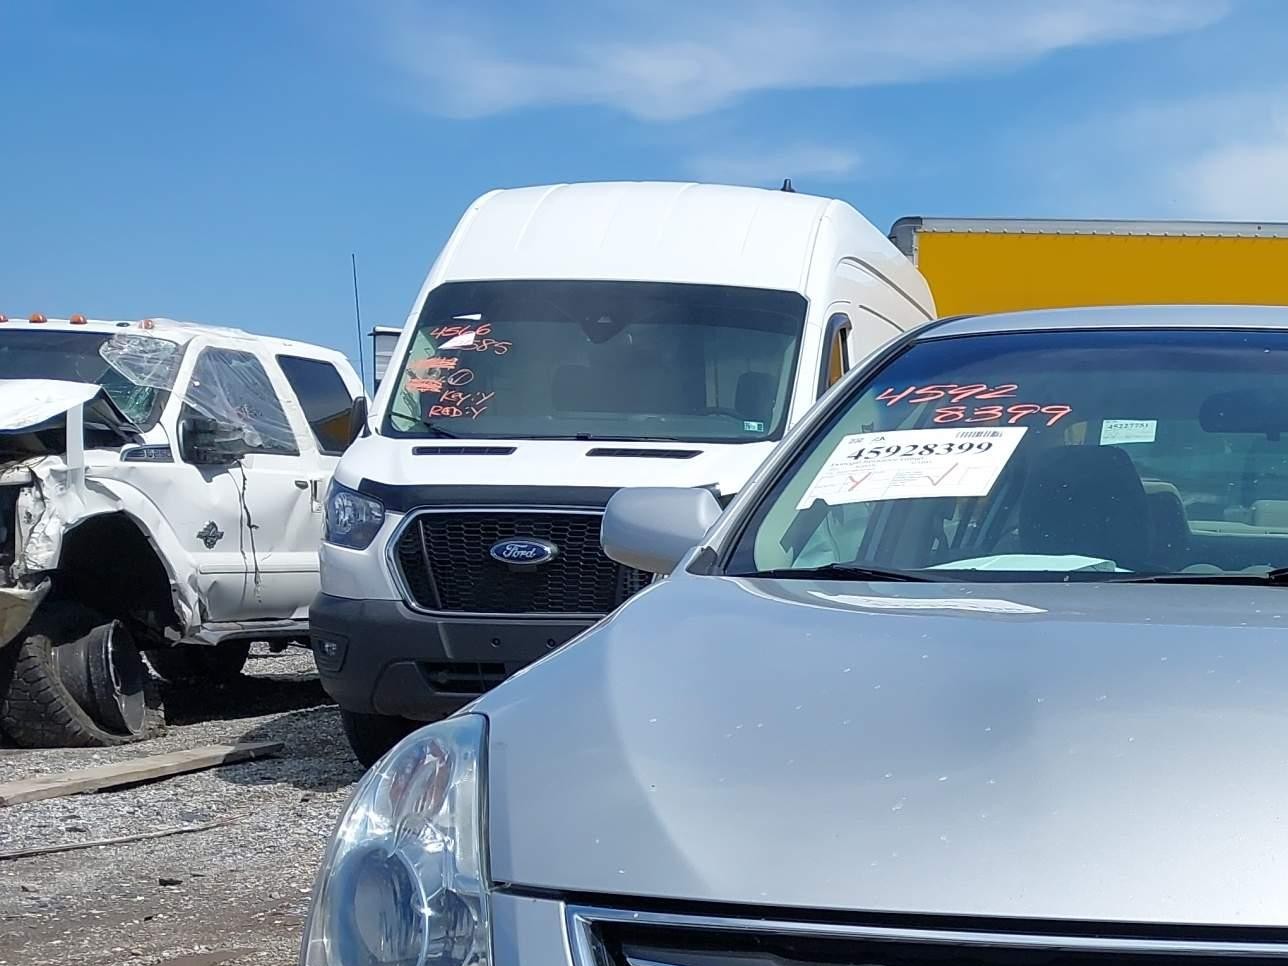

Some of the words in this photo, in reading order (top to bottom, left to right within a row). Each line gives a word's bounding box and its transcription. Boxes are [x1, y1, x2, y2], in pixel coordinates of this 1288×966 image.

[876, 384, 1018, 407] 4592
[934, 404, 1072, 427] 8399
[847, 442, 993, 461] 45928399
[502, 543, 537, 558] Ford
